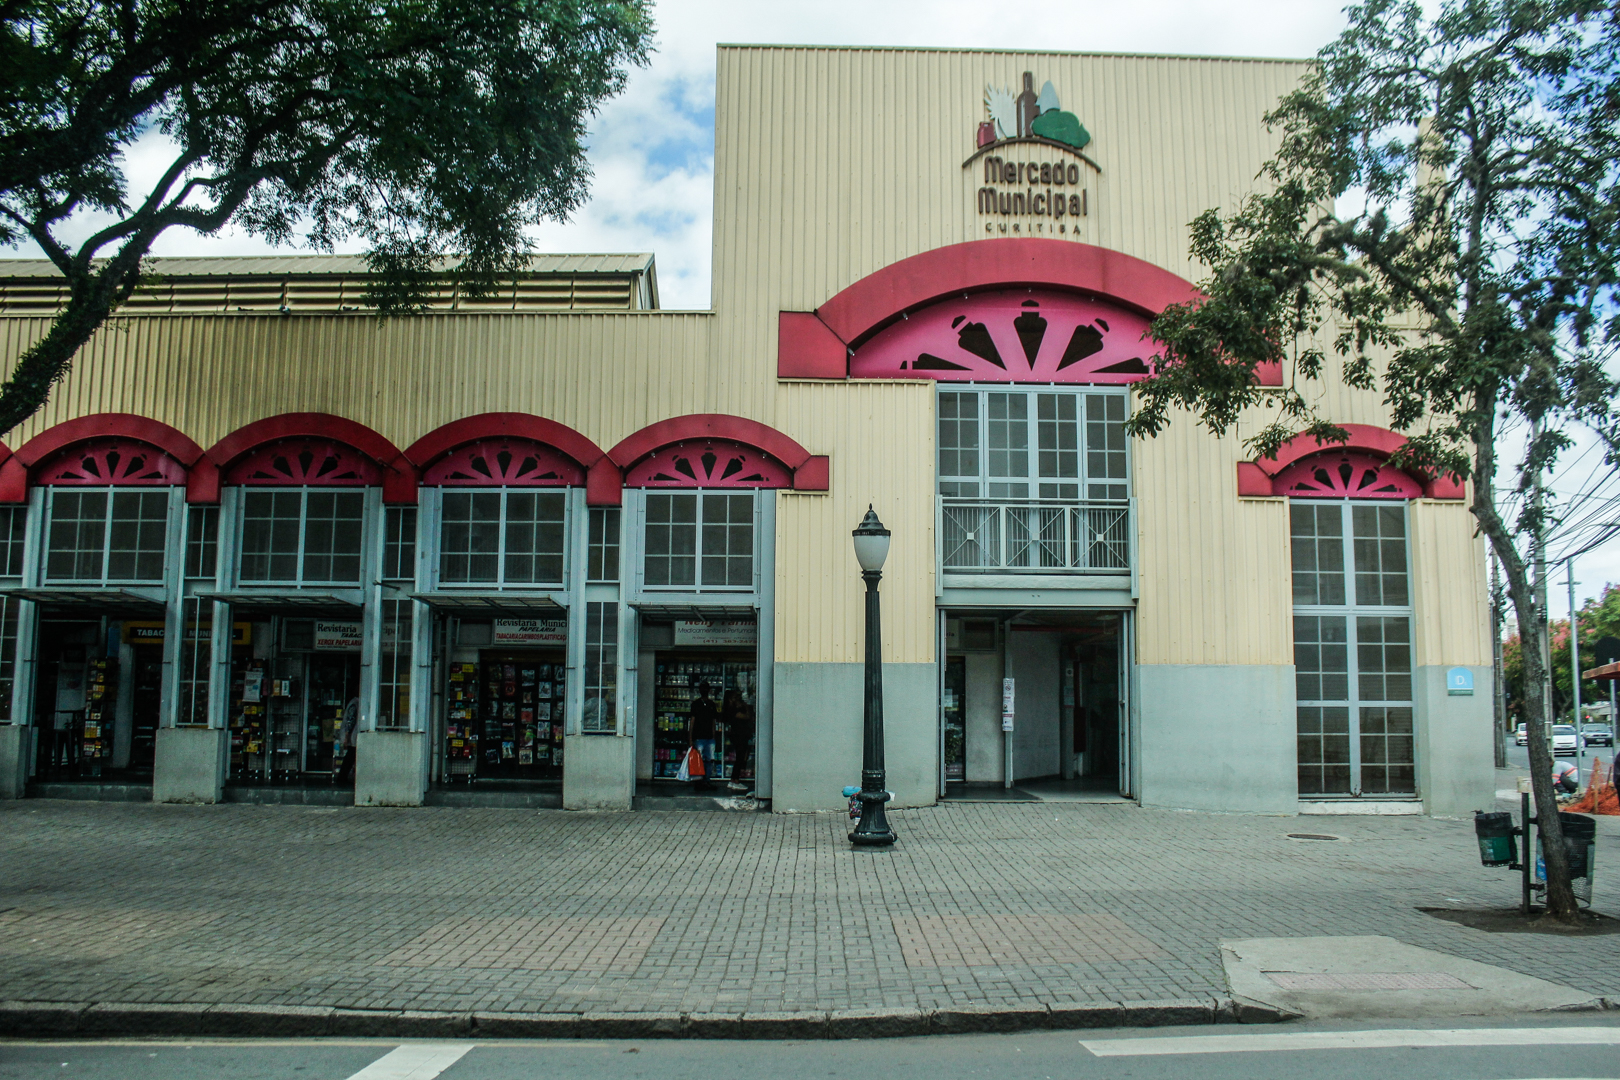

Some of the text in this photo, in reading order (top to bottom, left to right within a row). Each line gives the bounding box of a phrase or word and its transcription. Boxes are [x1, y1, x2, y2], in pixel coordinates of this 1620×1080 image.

[985, 155, 1079, 185] Mercado
[978, 187, 1087, 219] Municipal
[985, 222, 1081, 234] CURITIBA
[317, 623, 357, 633] Revistaria
[541, 619, 567, 627] Munici
[137, 629, 165, 637] TABAC
